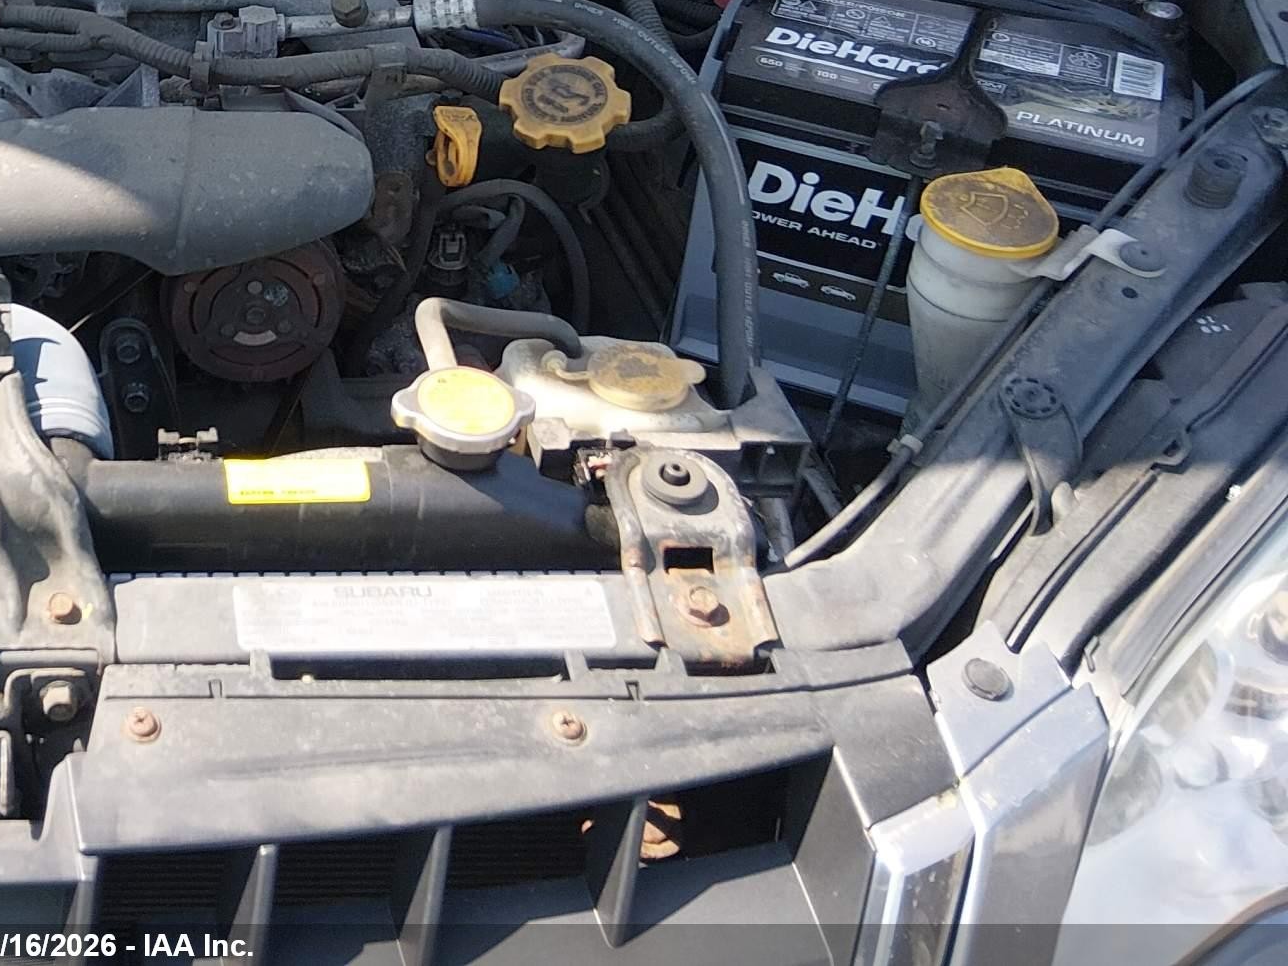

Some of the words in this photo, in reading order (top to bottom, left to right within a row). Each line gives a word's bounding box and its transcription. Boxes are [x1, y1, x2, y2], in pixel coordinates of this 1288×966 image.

[1016, 111, 1145, 147] PLATINUM
[748, 160, 922, 242] DieH
[751, 210, 804, 232] OWER
[807, 227, 877, 250] AHEAD
[333, 586, 433, 598] SUBARU
